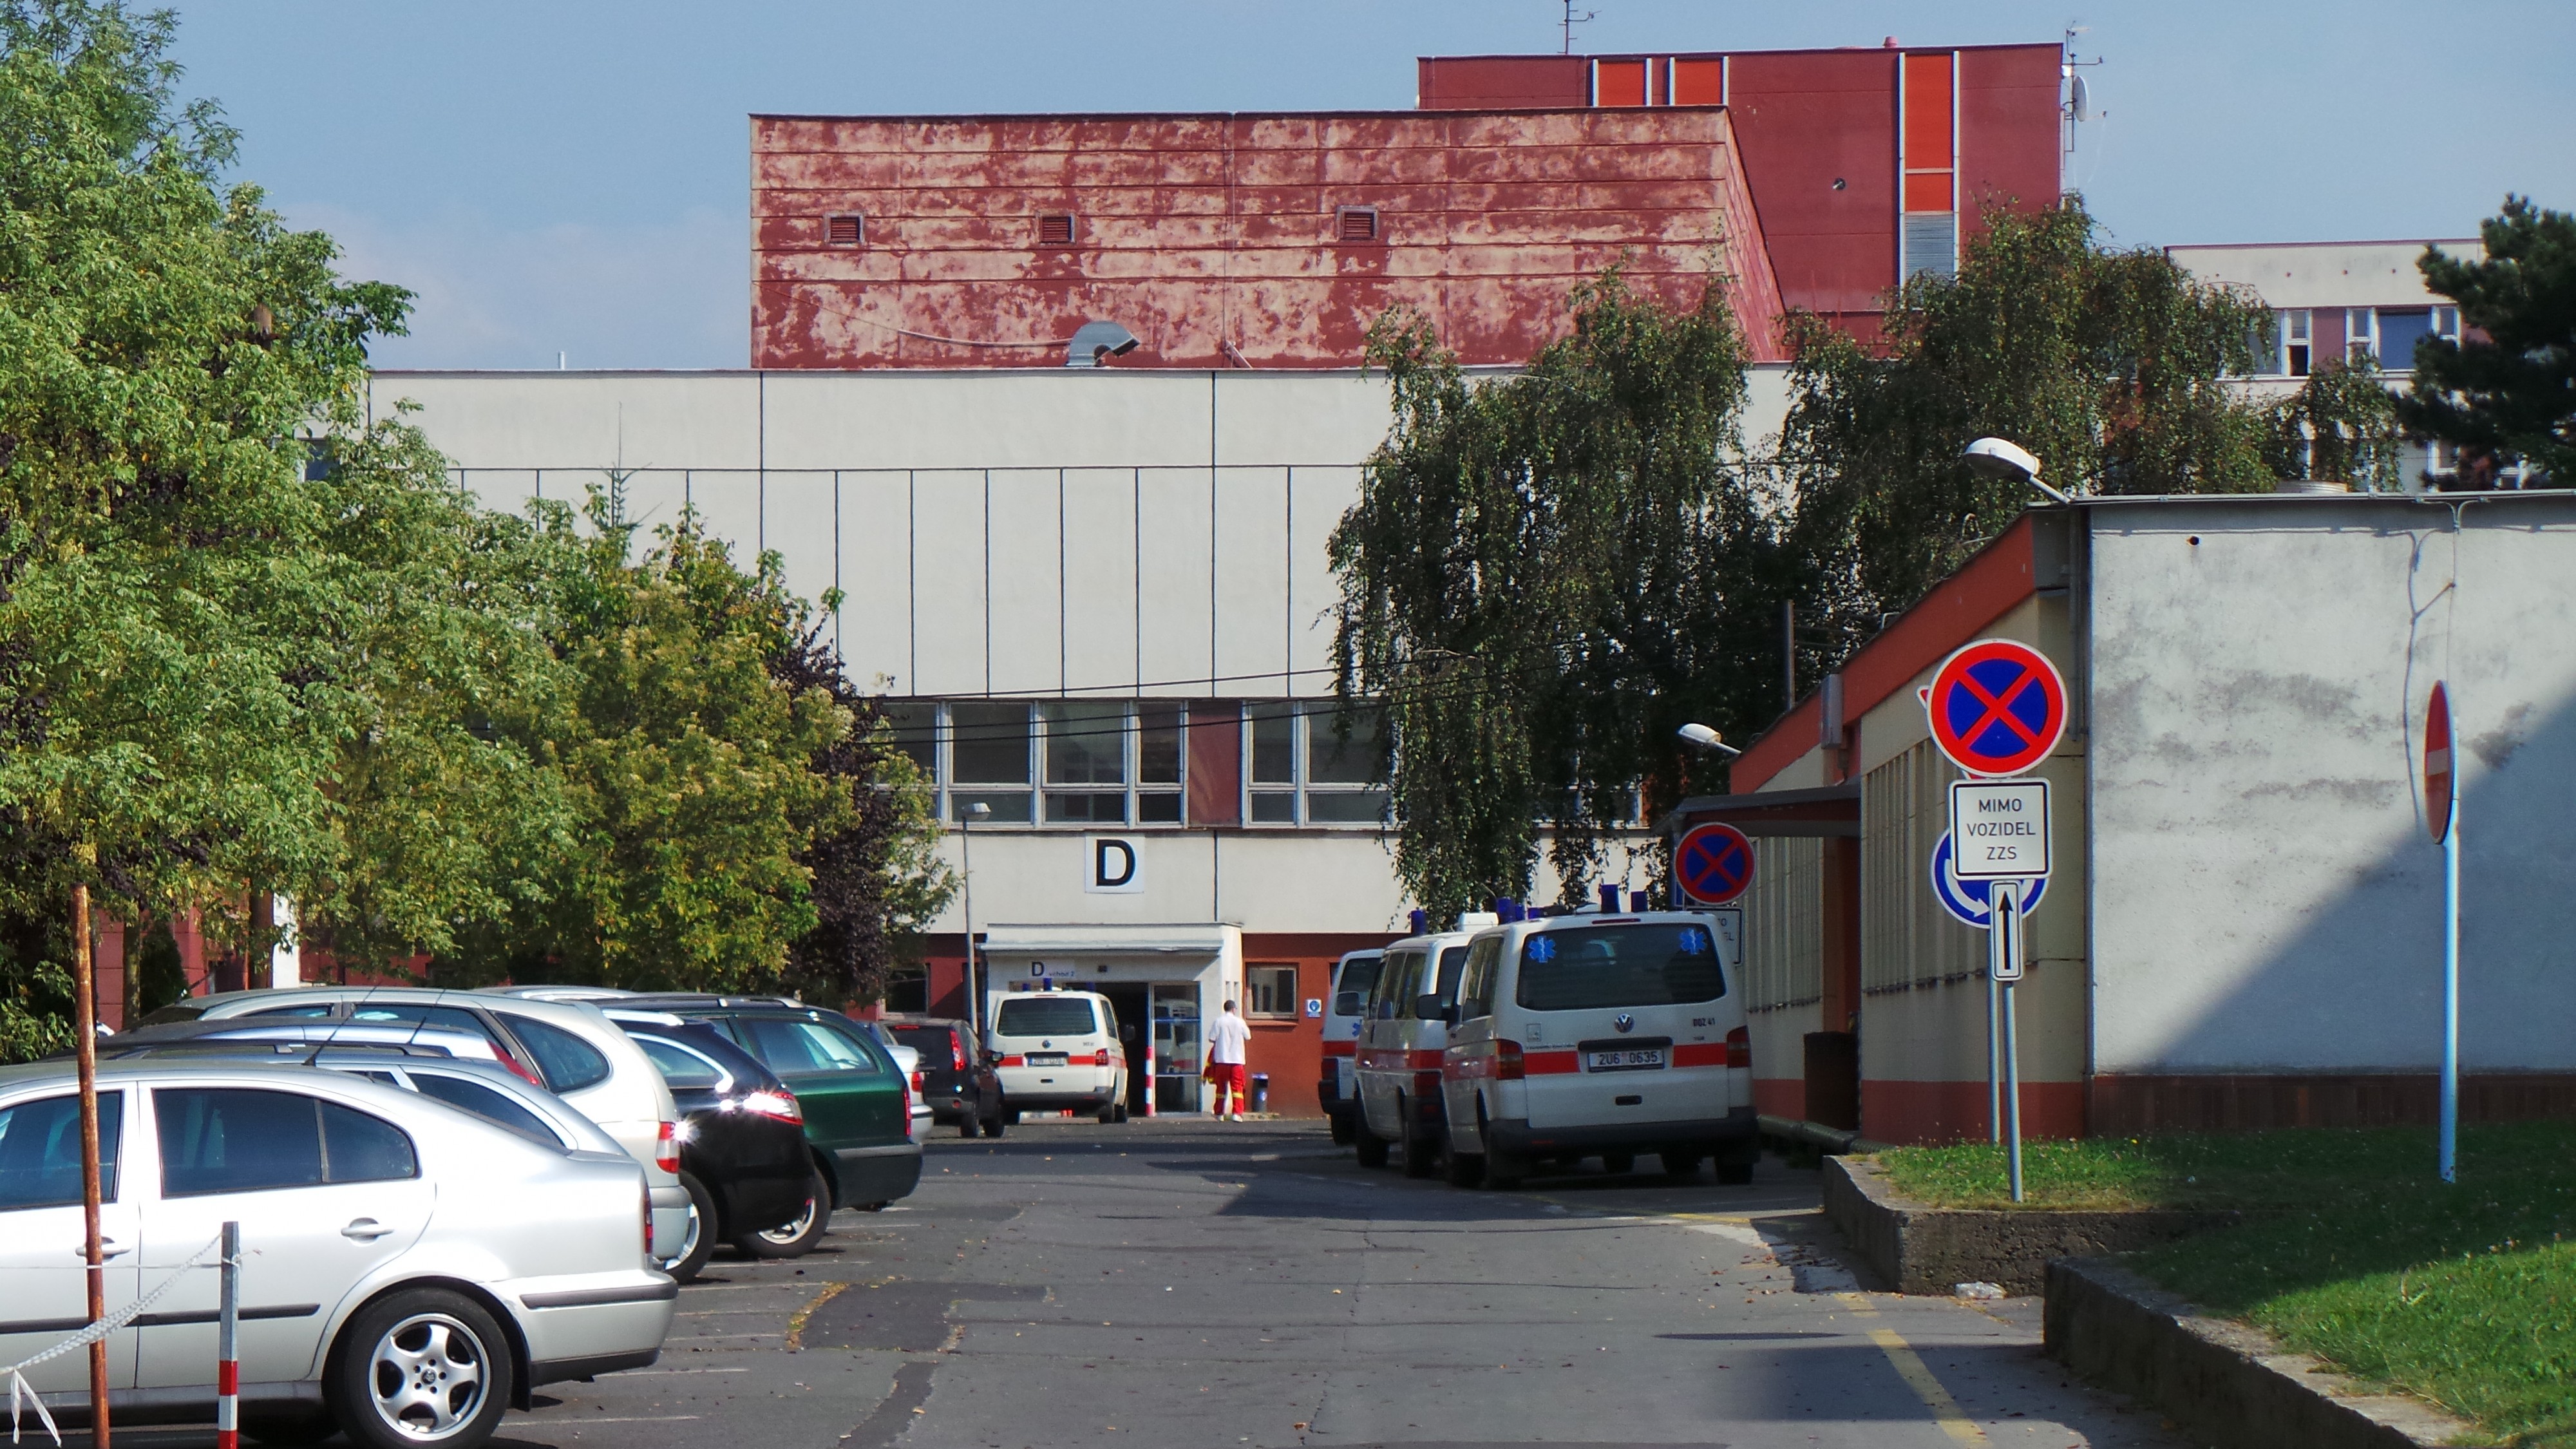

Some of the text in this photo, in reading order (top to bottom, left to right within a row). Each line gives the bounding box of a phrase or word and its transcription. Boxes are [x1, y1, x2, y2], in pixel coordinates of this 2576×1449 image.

[1978, 798, 2023, 813] MIMO
[1967, 822, 2036, 837] VOZIDEL
[1987, 846, 2017, 861] ZZS
[1096, 839, 1136, 887] D
[1032, 961, 1045, 976] D
[1599, 1052, 1658, 1066] 2U6 0635
